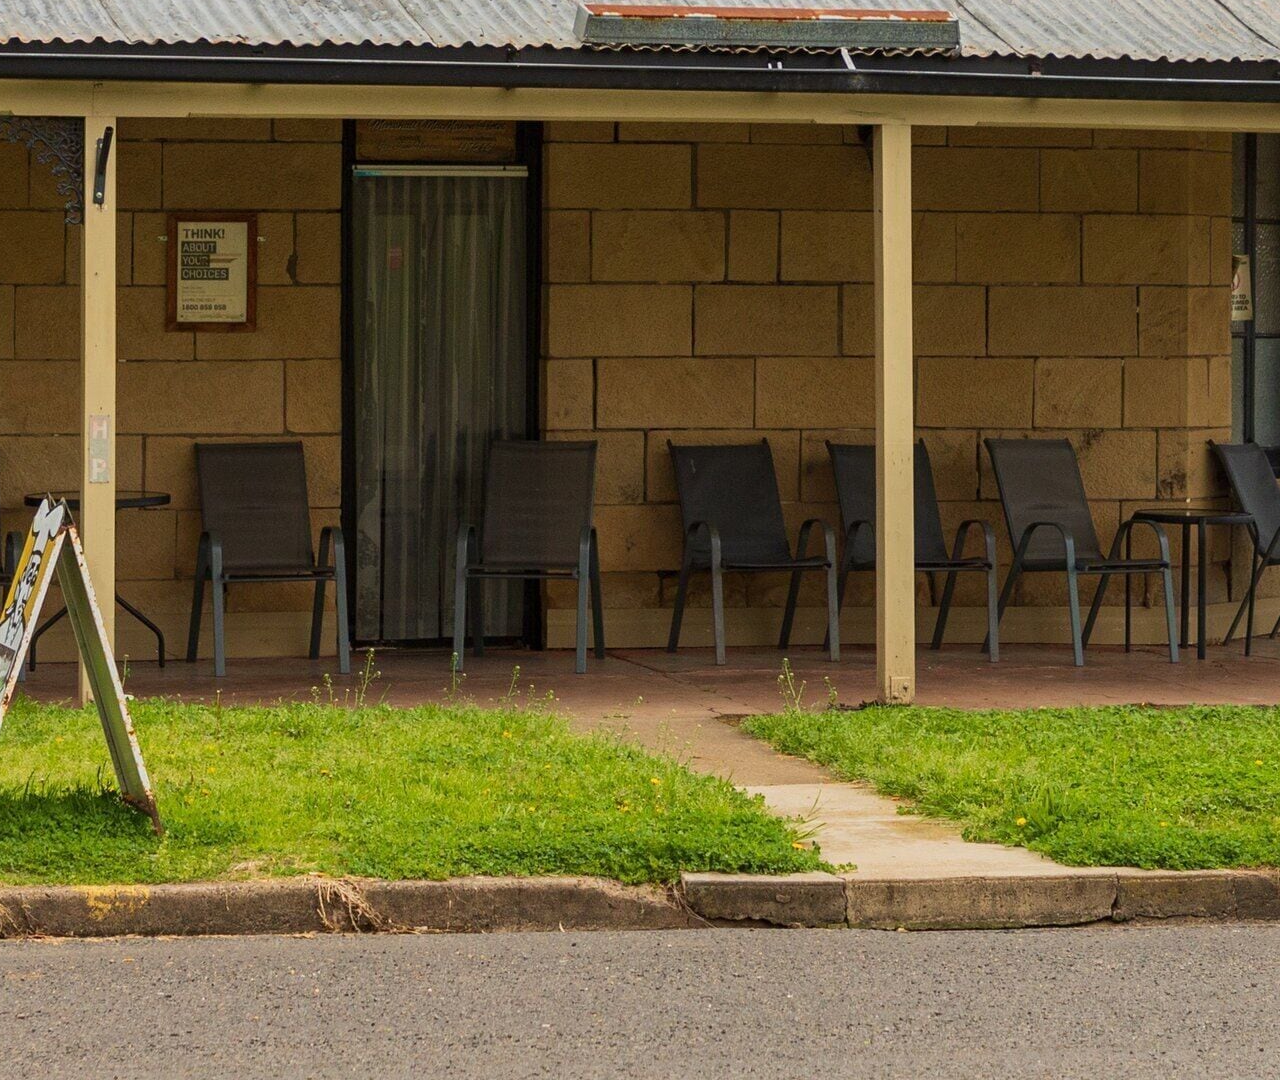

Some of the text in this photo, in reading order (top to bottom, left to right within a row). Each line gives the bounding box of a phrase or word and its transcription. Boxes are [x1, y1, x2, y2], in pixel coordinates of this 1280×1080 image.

[183, 228, 225, 239] THINK!
[183, 243, 215, 252] ABOUT
[182, 256, 208, 266] YOUR
[182, 269, 227, 279] CHOICES
